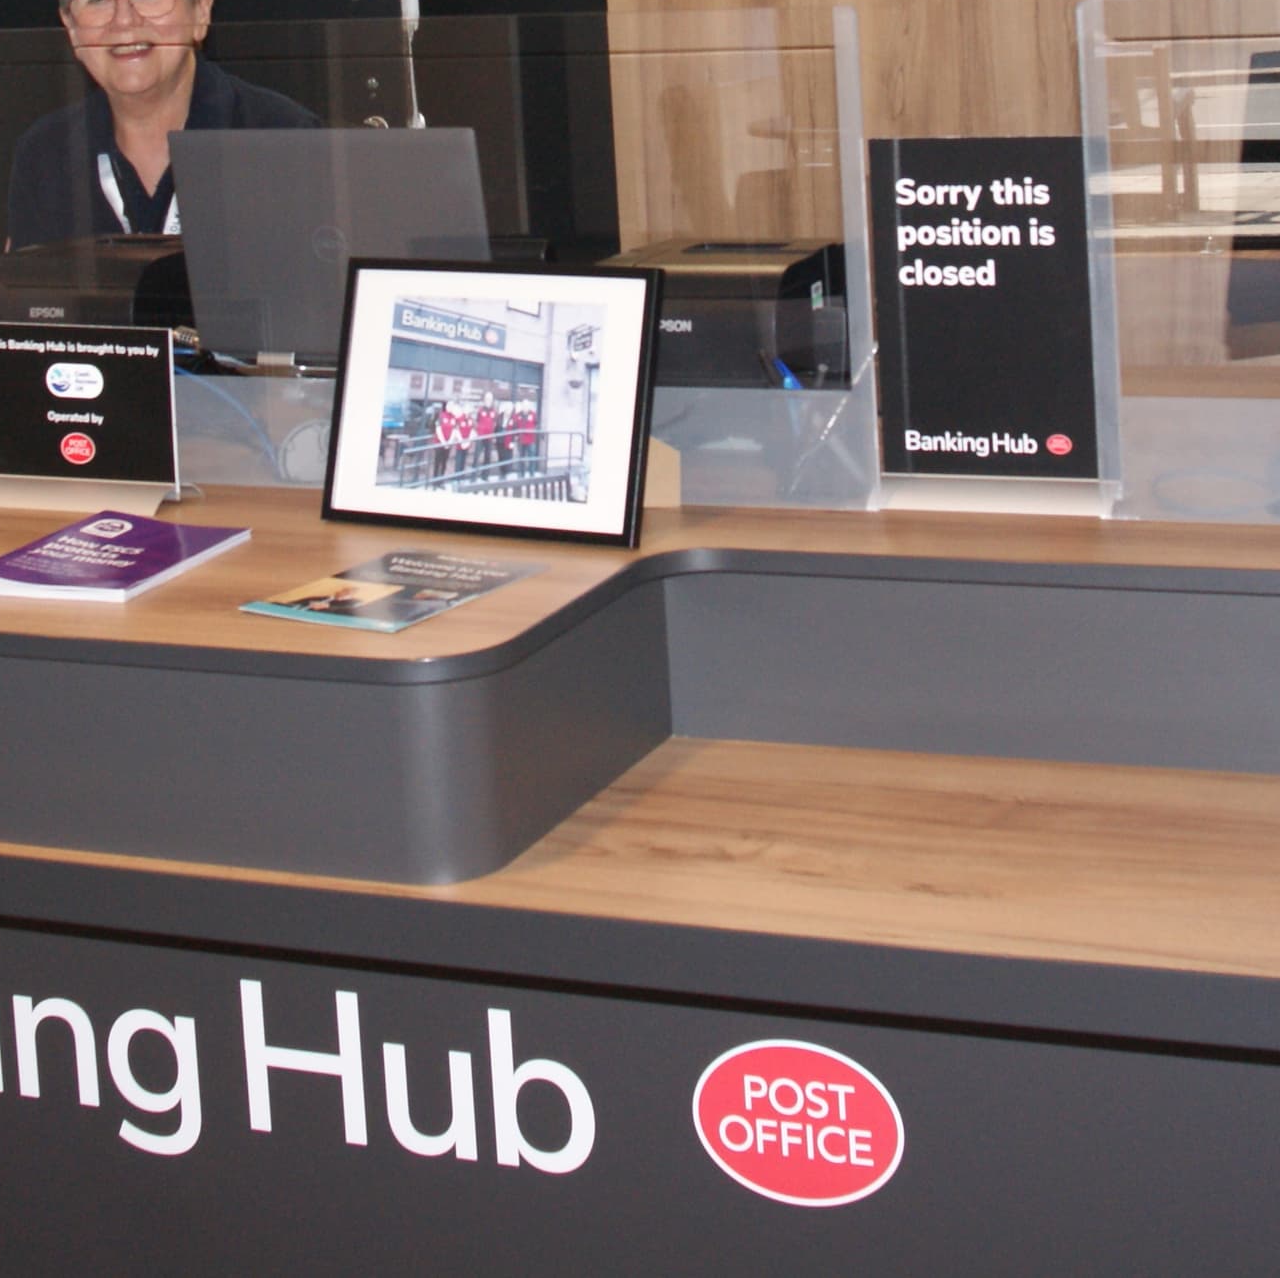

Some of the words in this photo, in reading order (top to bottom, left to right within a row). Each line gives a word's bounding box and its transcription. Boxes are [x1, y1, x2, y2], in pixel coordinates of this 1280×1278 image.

[895, 177, 983, 211] Sorry
[989, 176, 1051, 206] this
[896, 217, 1022, 252] position
[1028, 217, 1056, 247] is
[898, 258, 997, 288] closed
[29, 306, 65, 320] EPSON
[402, 308, 456, 339] Banking
[457, 322, 482, 341] Hub
[659, 319, 693, 332] PSON
[8, 339, 45, 353] Banking
[46, 341, 66, 353] Hub
[67, 342, 76, 353] is
[76, 342, 115, 356] brought
[115, 345, 126, 355] to
[127, 346, 146, 357] you
[146, 345, 160, 358] by
[47, 410, 90, 424] Operated
[91, 412, 104, 426] by
[904, 429, 990, 458] Banking
[992, 432, 1039, 455] Hub
[43, 541, 119, 559] protects
[57, 535, 100, 550] How
[28, 548, 71, 559] your
[72, 554, 136, 568] money
[391, 556, 456, 572] Welcome
[389, 564, 448, 579] Banking
[449, 573, 481, 582] Hub
[239, 979, 597, 1175] Hub
[743, 1074, 856, 1122] POST
[718, 1114, 875, 1168] OFFICE
